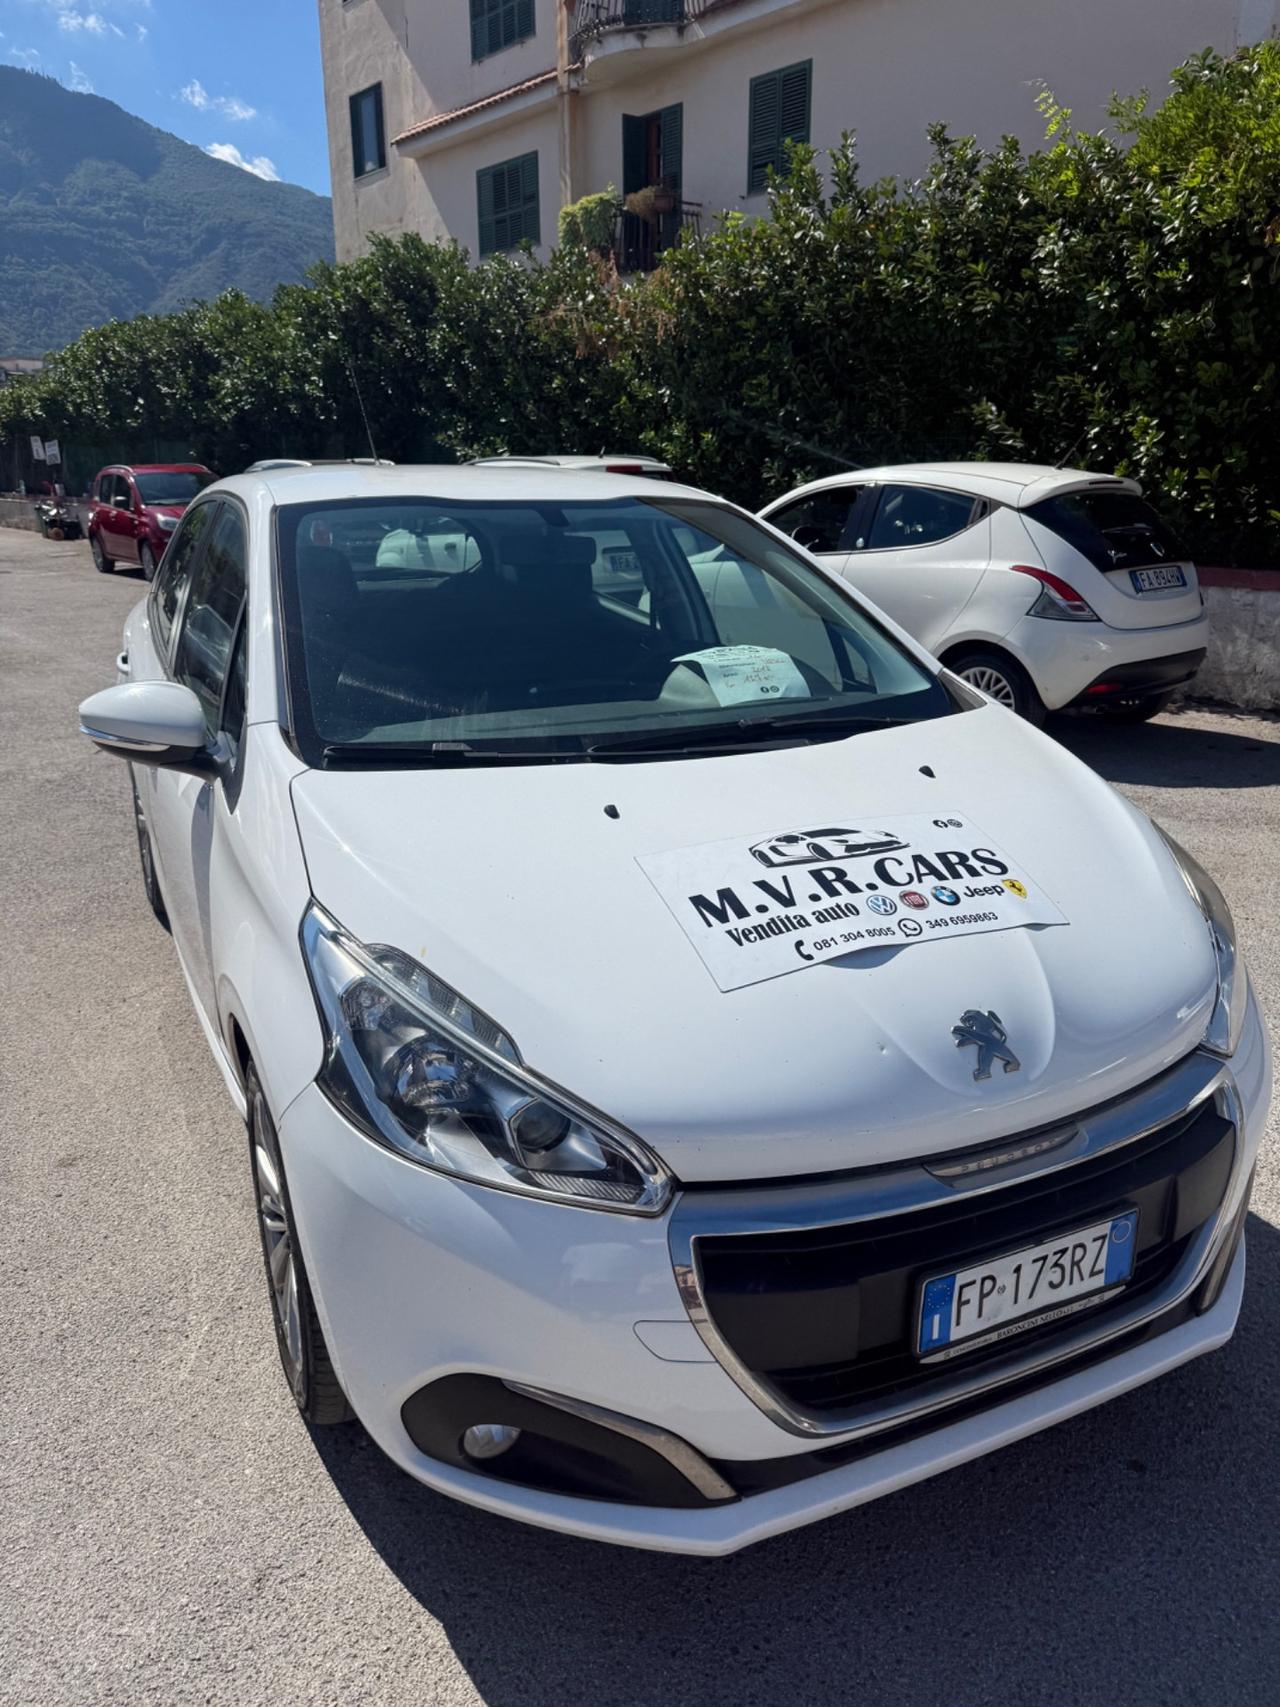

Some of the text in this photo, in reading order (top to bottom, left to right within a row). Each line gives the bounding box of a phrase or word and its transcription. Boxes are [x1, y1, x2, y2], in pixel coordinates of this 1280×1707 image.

[1139, 571, 1153, 588] FA
[689, 849, 1008, 928] M.V.R.CARS
[963, 885, 1005, 898] Jeep
[725, 902, 860, 947] Vendita auto
[926, 911, 999, 929] 349 6959863
[813, 927, 896, 951] 081 304 8005
[955, 1274, 997, 1327] FP
[1012, 1233, 1108, 1305] 173RZ
